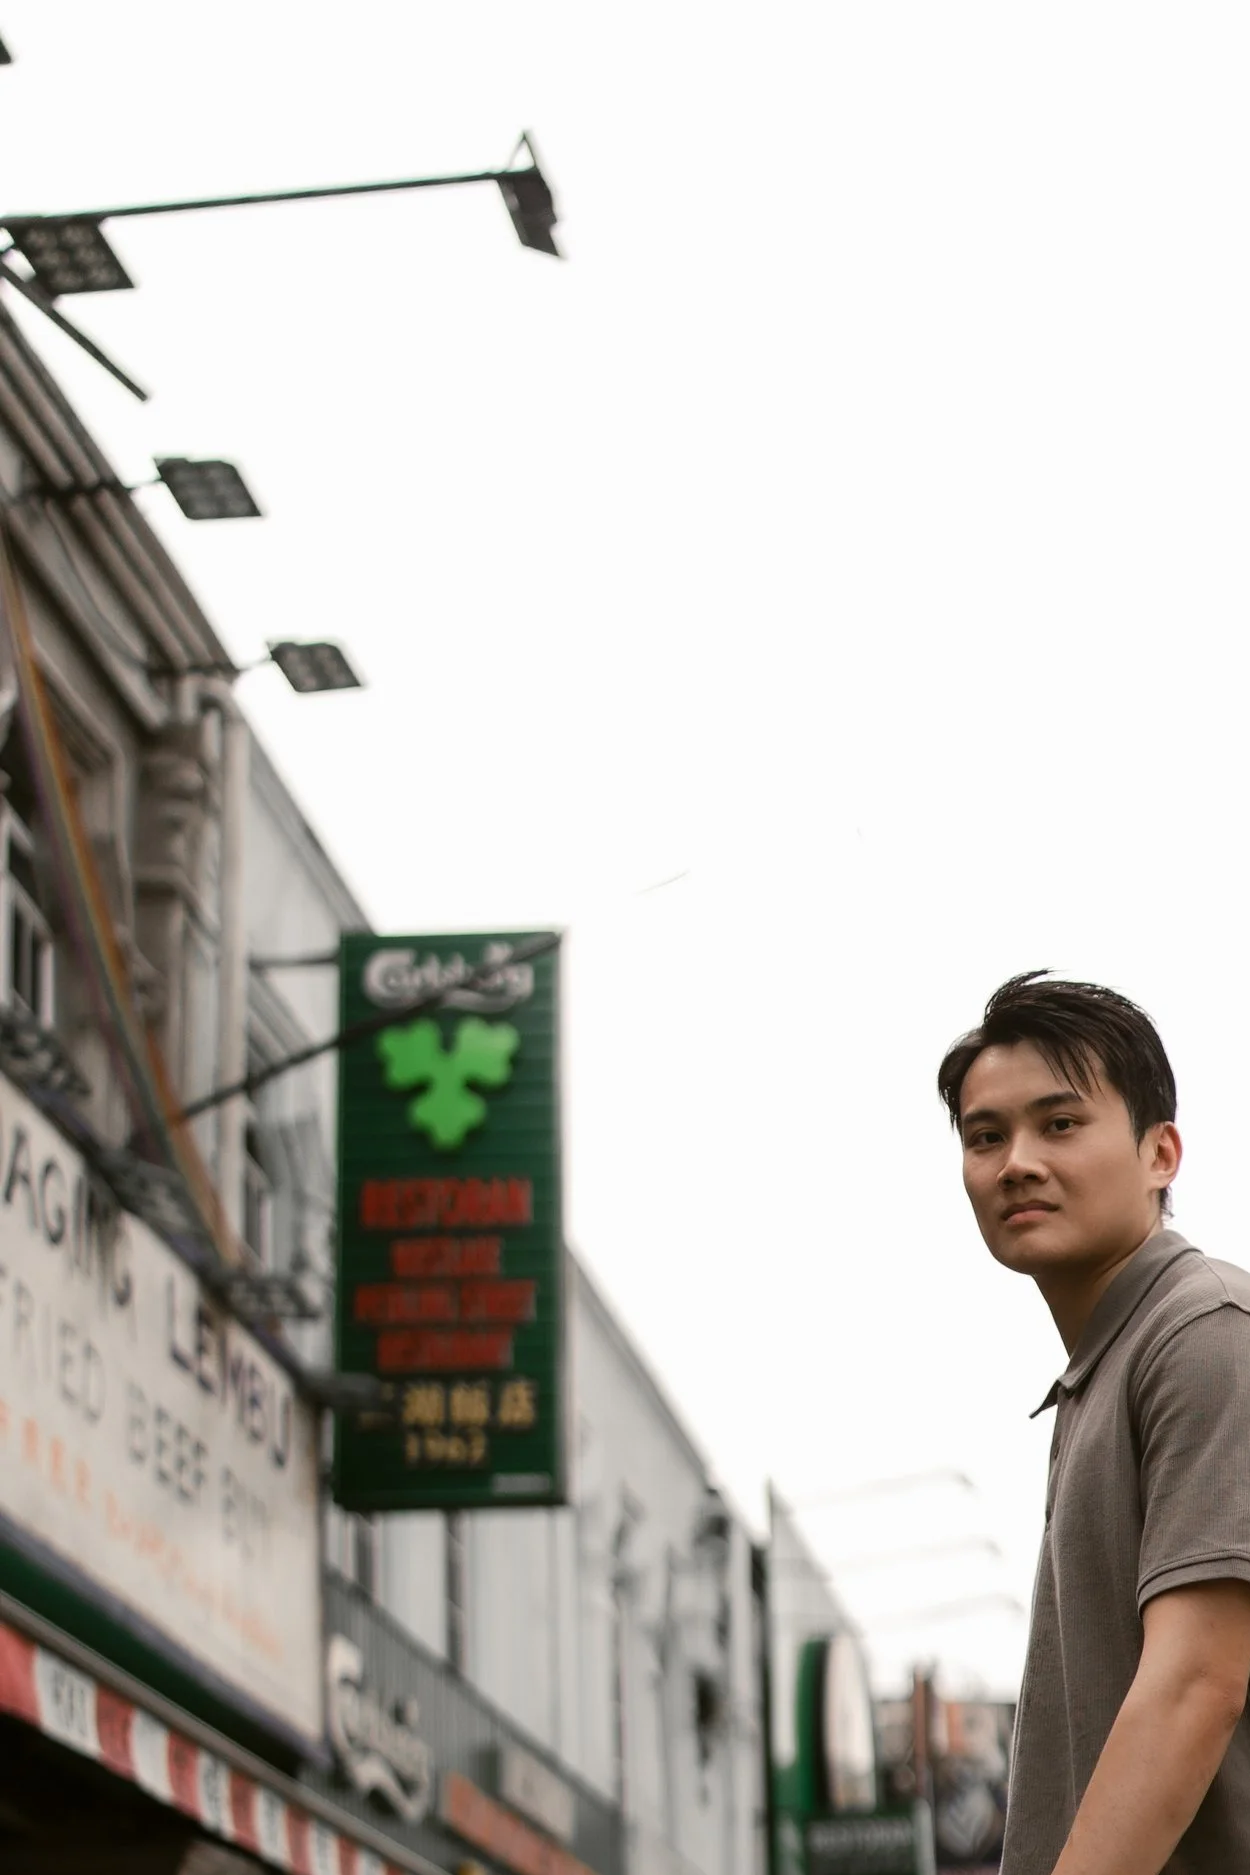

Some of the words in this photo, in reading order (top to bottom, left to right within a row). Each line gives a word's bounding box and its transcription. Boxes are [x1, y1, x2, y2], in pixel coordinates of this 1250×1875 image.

[0, 1125, 131, 1308] AGING
[167, 1272, 290, 1470] LEMBU
[127, 1378, 206, 1505] BEEF
